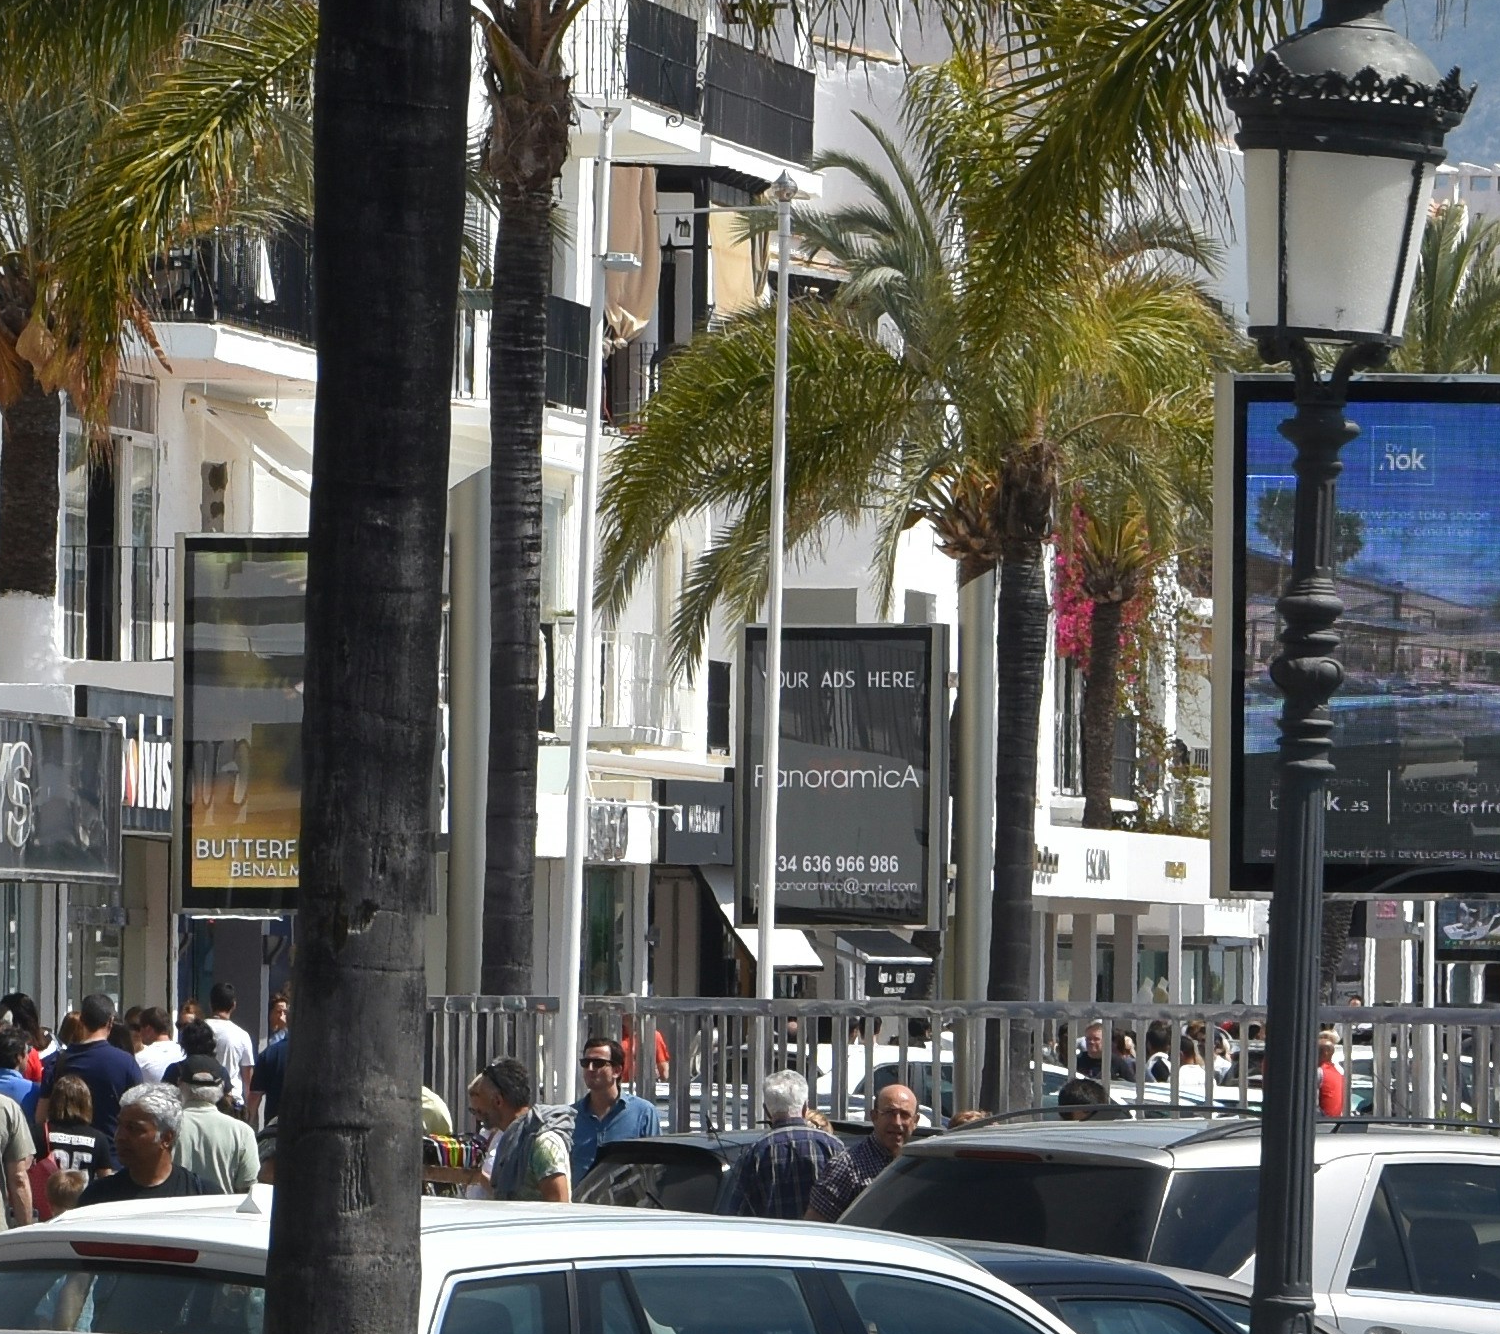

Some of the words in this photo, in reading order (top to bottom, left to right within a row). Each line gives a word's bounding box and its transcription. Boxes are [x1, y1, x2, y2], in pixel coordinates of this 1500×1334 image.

[762, 671, 809, 688] OUR
[821, 671, 856, 688] ADS
[867, 671, 916, 688] HERE
[1452, 799, 1478, 814] for
[774, 855, 797, 872] 34
[802, 855, 832, 873] 636
[836, 855, 865, 873] 966
[869, 855, 899, 873] 986
